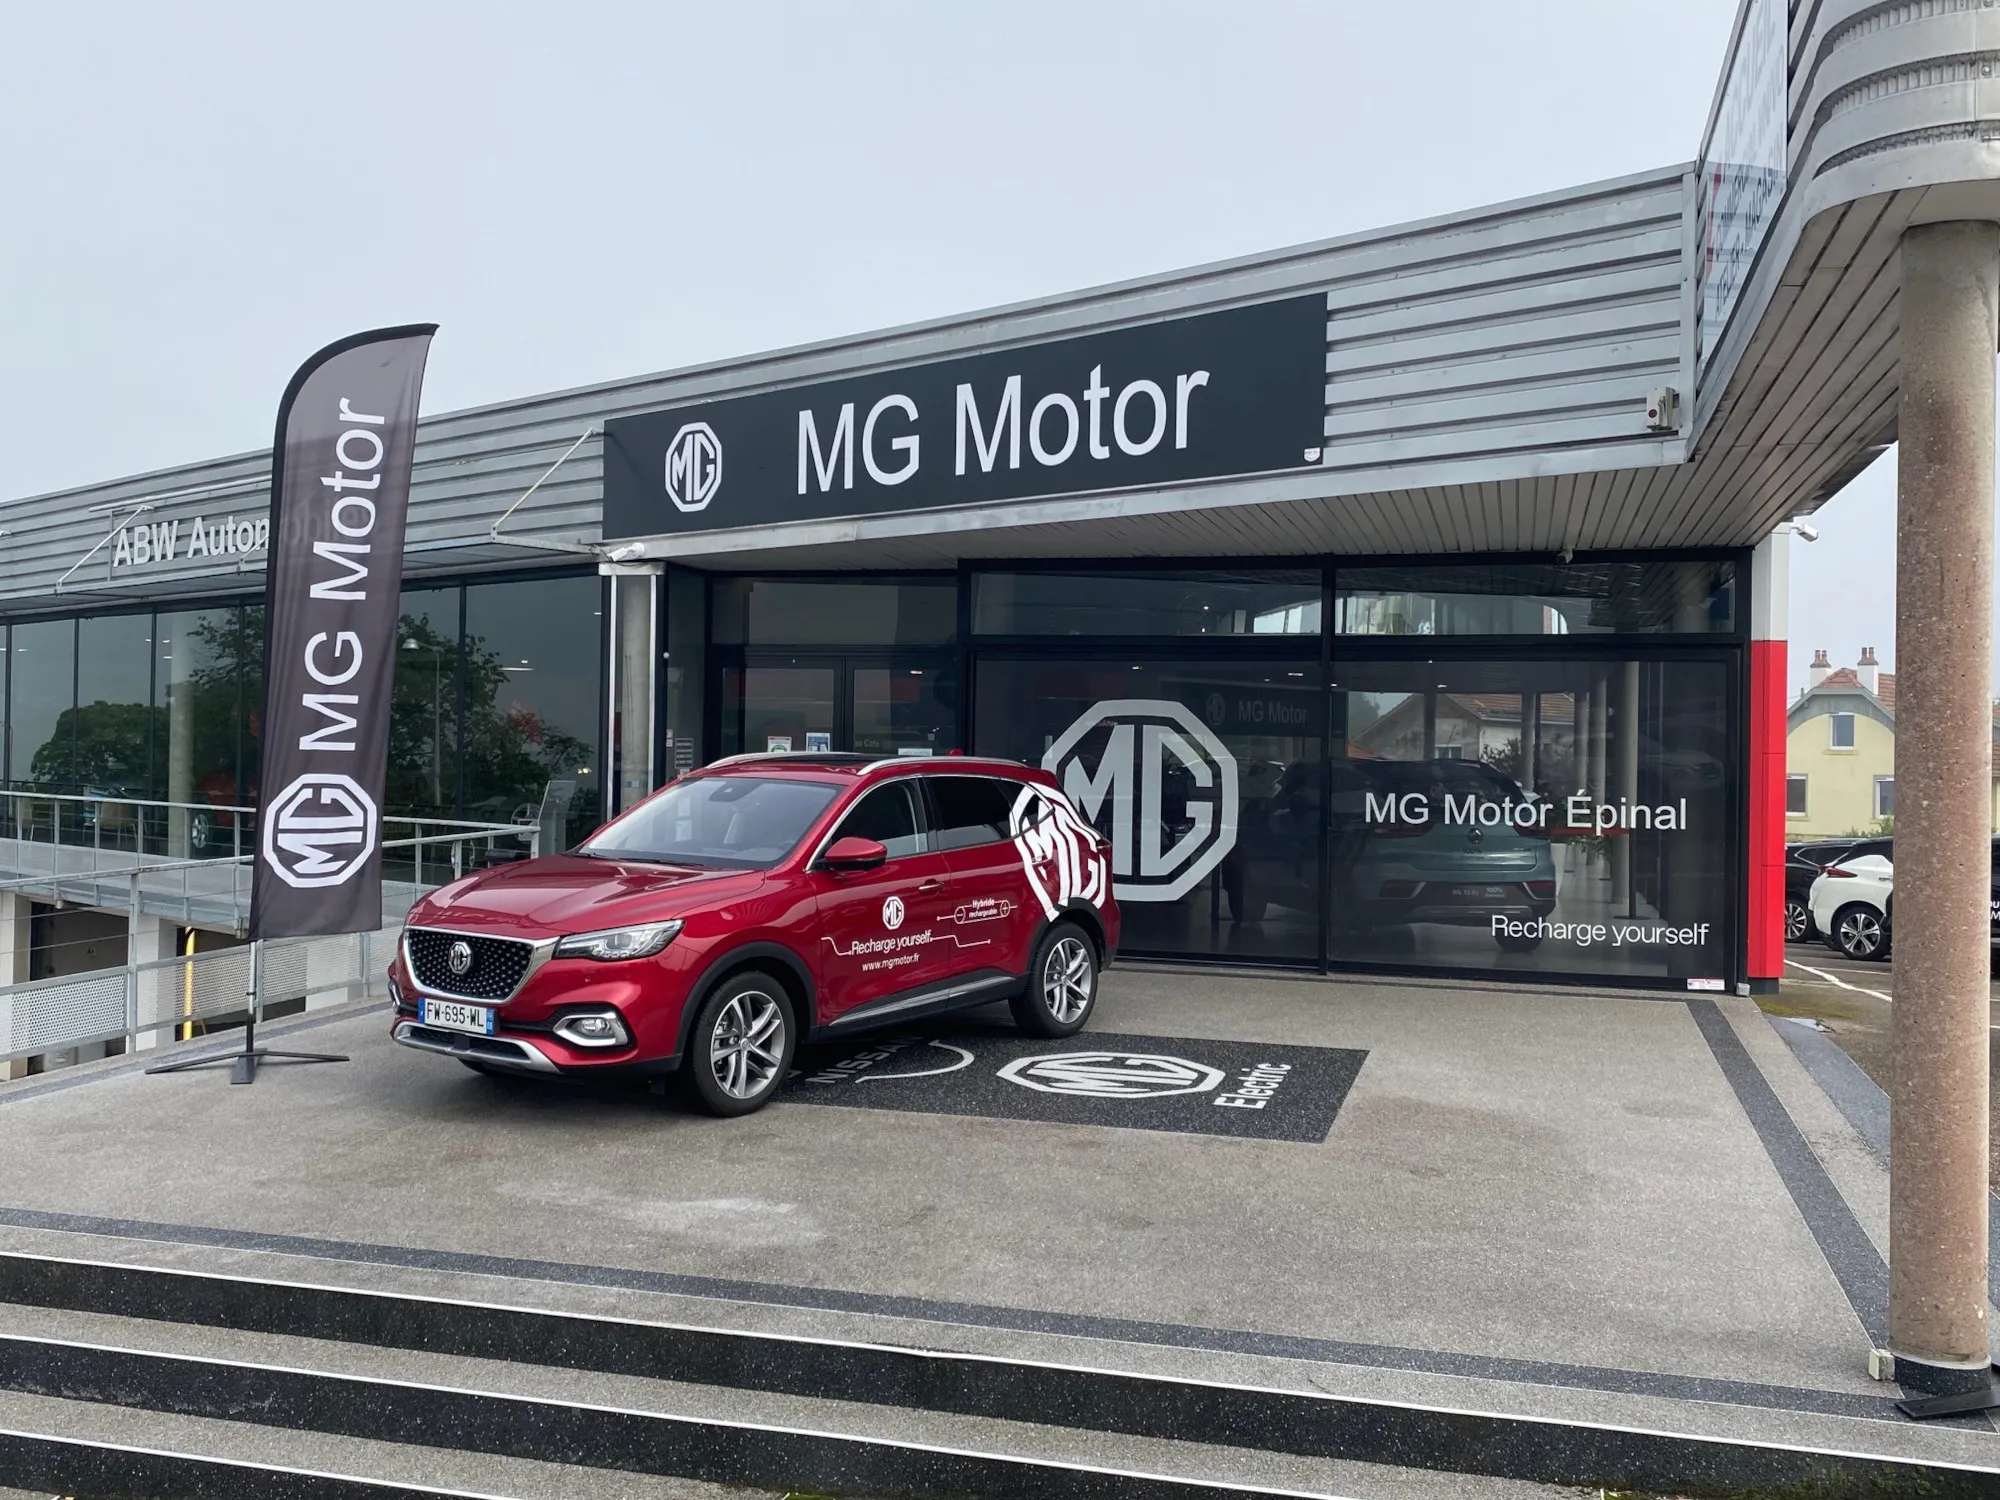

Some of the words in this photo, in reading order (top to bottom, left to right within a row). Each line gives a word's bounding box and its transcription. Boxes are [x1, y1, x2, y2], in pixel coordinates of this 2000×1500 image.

[797, 393, 920, 495] MG
[954, 363, 1211, 476] Motor
[669, 430, 717, 504] MG
[309, 396, 388, 601] Motor
[112, 519, 178, 568] ABW
[298, 631, 363, 752] MG
[1238, 700, 1264, 723] MG
[1268, 701, 1309, 725] Motor
[274, 784, 367, 877] MG
[1364, 792, 1430, 826] MG
[1443, 793, 1554, 828] Motor
[1566, 788, 1688, 837] Épinal
[972, 898, 995, 909] Hybride
[851, 936, 897, 957] Recharge
[896, 929, 932, 951] yourself
[1490, 914, 1607, 947] Recharge
[1611, 922, 1711, 947] yourself
[862, 953, 920, 972] www.mgmotor.fr
[427, 1002, 484, 1028] FW-695-WL
[1213, 1063, 1292, 1110] Electric
